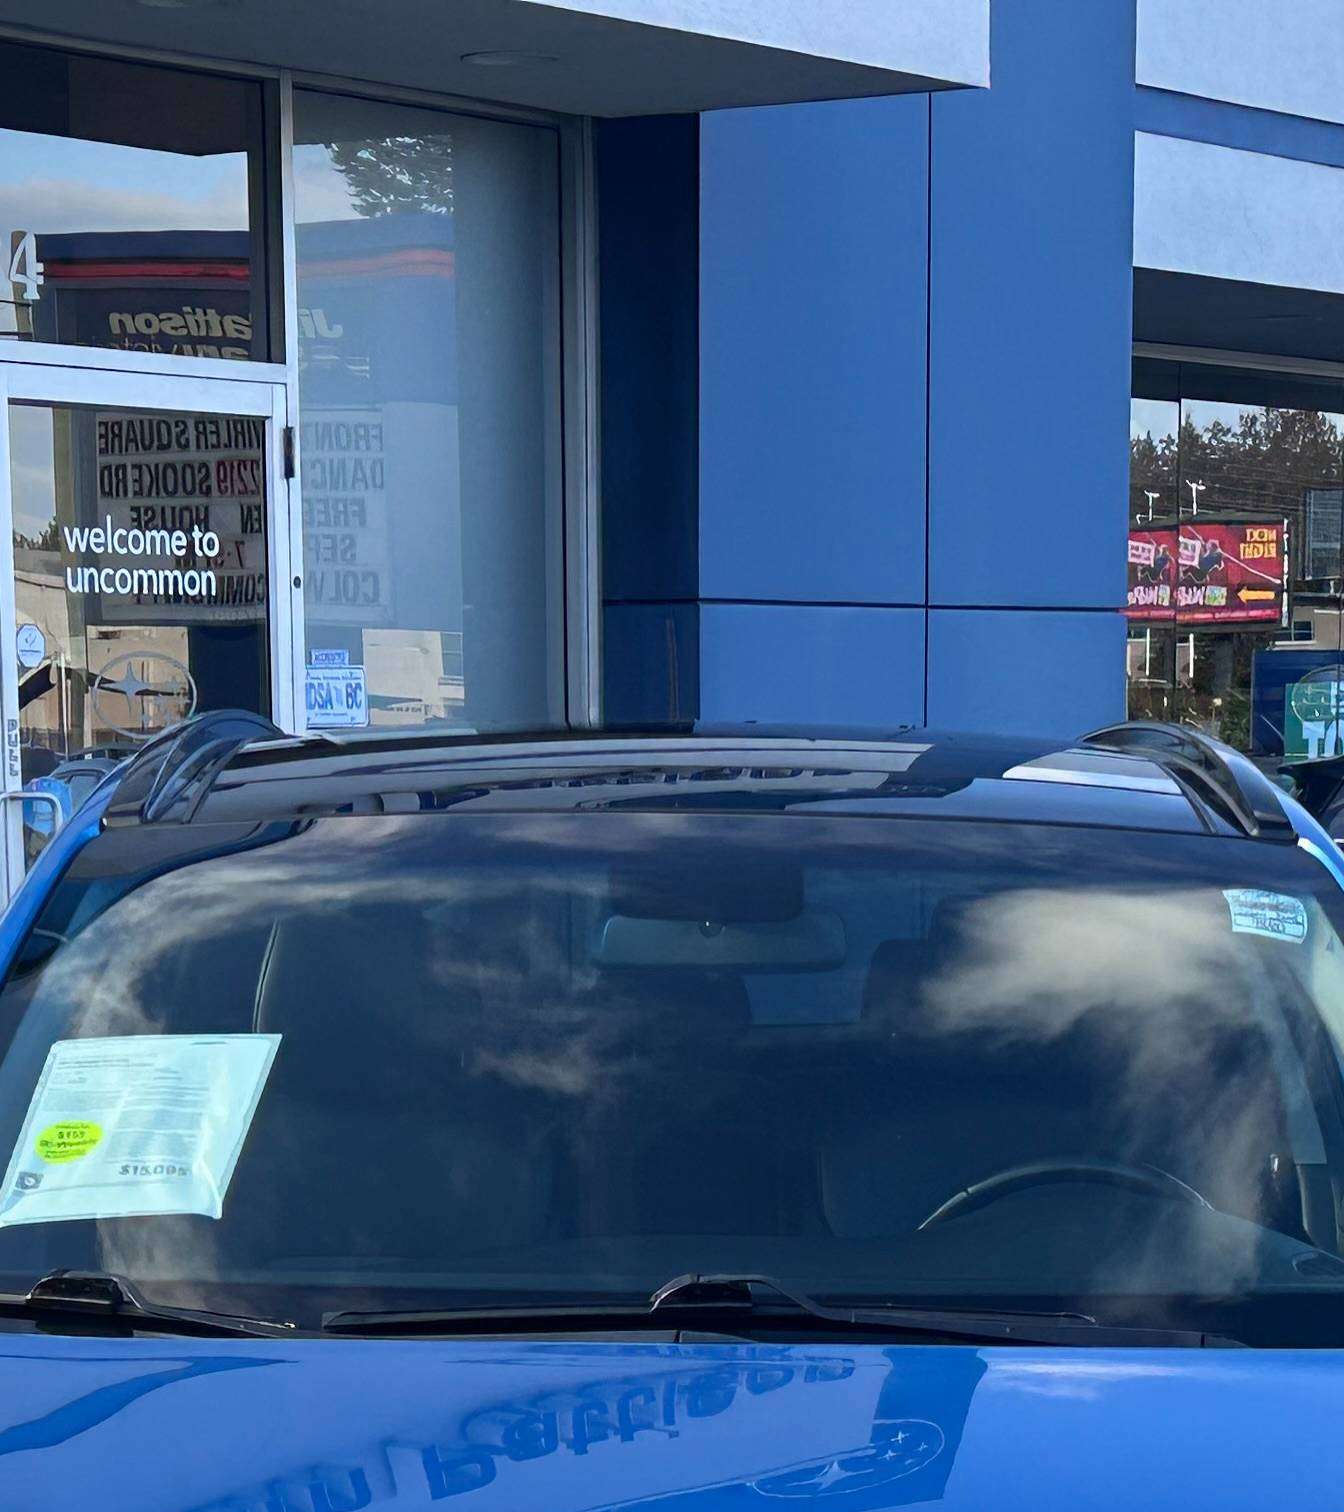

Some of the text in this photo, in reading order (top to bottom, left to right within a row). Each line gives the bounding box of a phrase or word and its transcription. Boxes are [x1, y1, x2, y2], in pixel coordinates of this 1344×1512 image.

[63, 514, 220, 557] welcome to
[66, 565, 217, 597] uncommon
